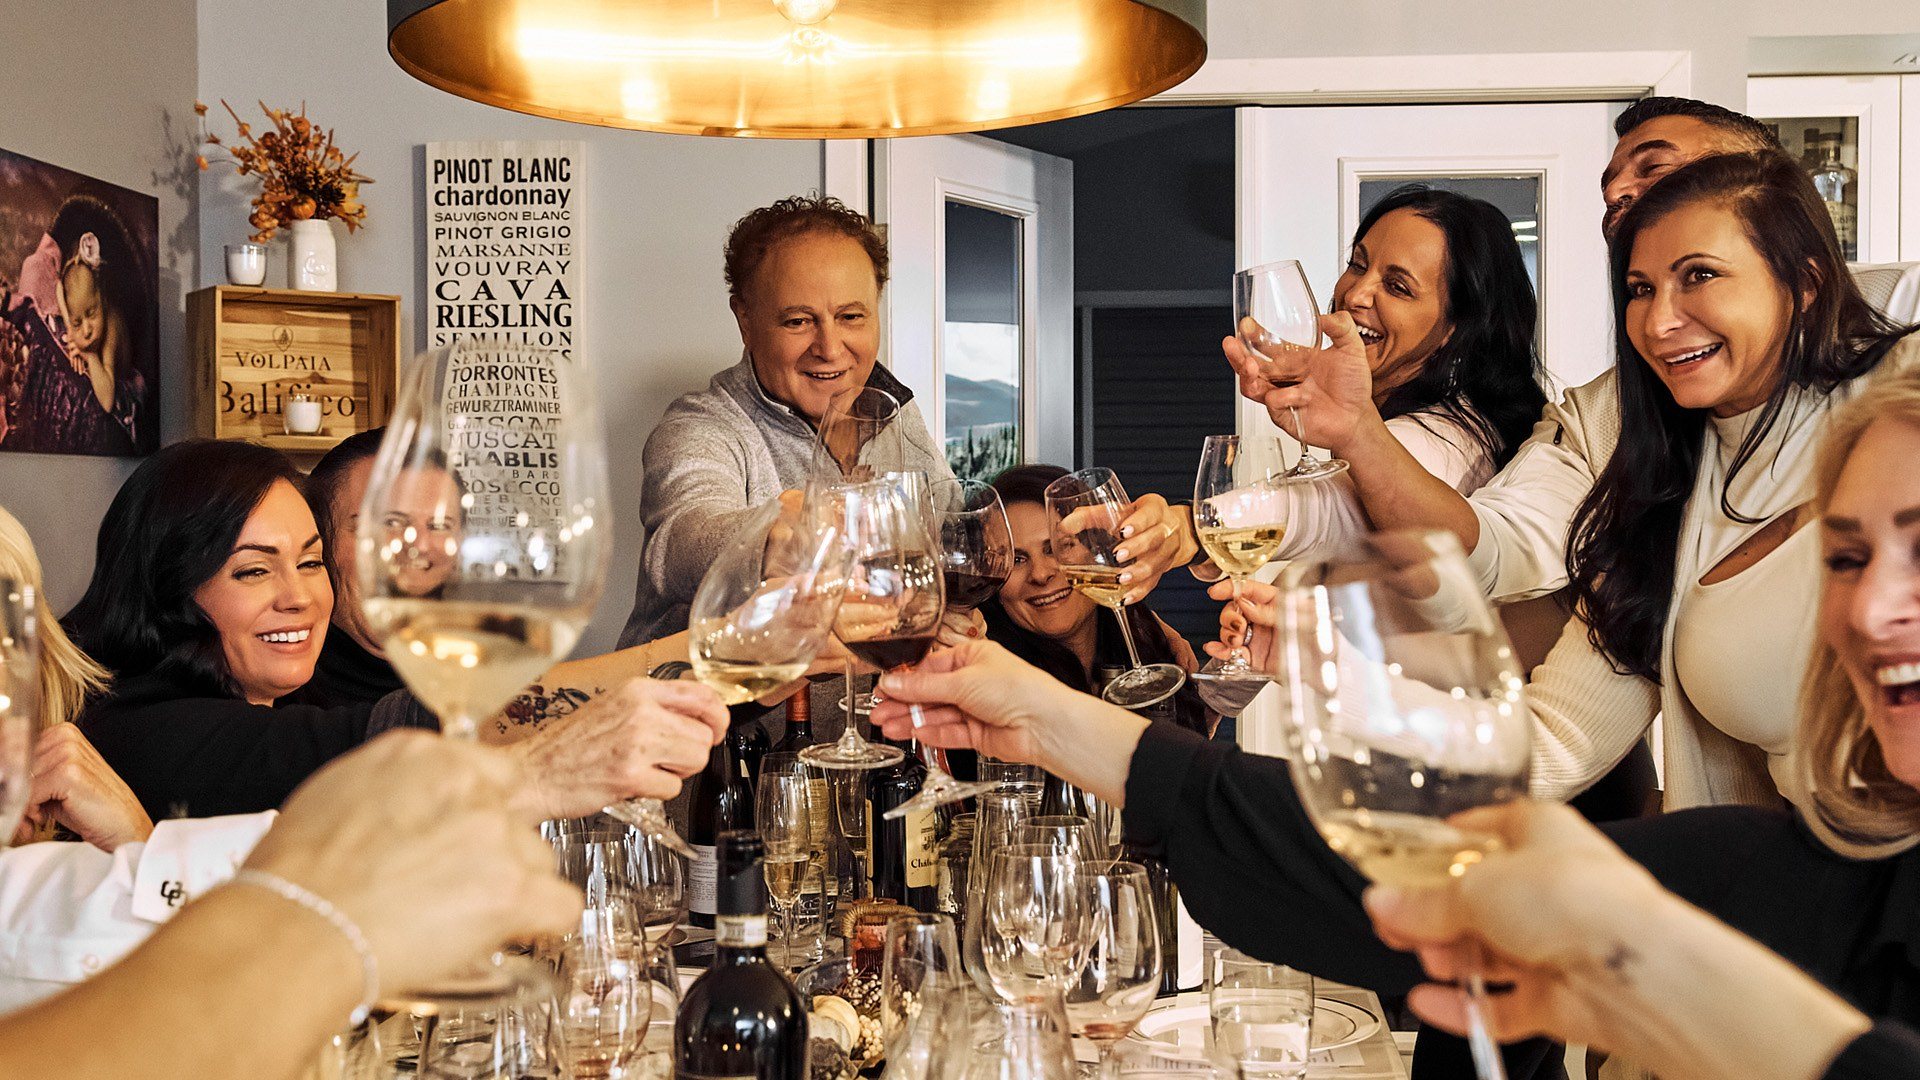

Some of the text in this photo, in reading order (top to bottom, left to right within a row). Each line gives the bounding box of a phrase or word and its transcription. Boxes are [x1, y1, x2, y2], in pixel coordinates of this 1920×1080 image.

[434, 157, 571, 184] PINOT BLANC
[434, 185, 571, 209] chardonnay
[434, 210, 571, 222] SAUVIGNON BLANC
[435, 226, 571, 240] PINOT GRIGIO
[436, 243, 571, 258] MARSANNE
[435, 260, 571, 277] VOUVRAY
[435, 278, 571, 302] CAVA
[436, 303, 572, 328] RIESLING
[435, 331, 572, 347] SEMILLON
[235, 351, 331, 371] VOLPAIA
[452, 365, 558, 384] TORRONTES
[448, 382, 560, 399] CHAMPAGNE
